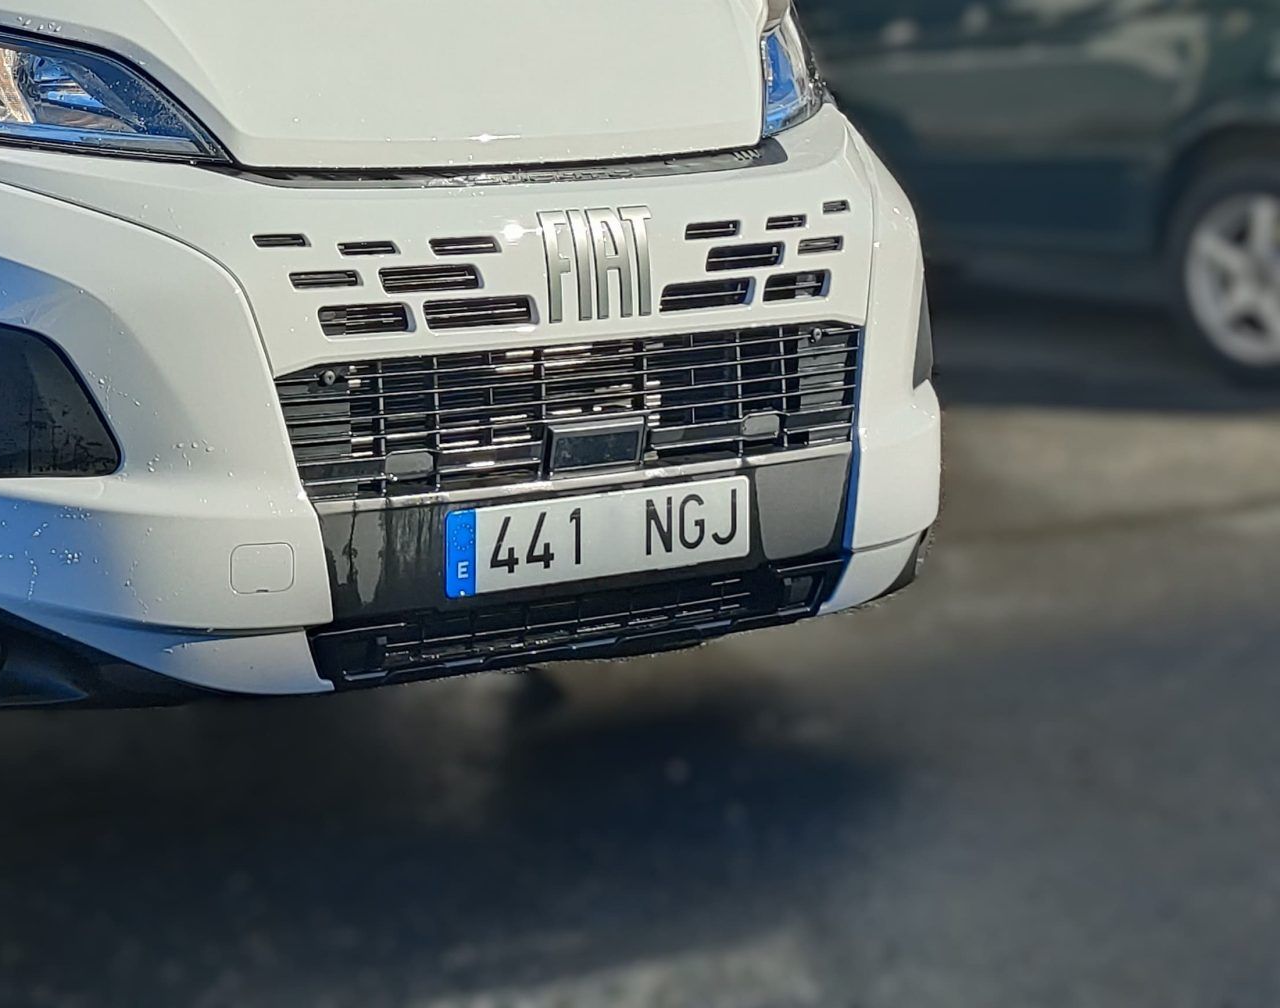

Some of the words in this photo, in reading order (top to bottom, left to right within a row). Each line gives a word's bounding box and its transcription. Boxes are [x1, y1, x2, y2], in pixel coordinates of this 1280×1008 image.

[536, 205, 652, 324] FIAT
[457, 561, 469, 579] E
[490, 507, 581, 574] 441
[646, 488, 737, 556] NGJ
